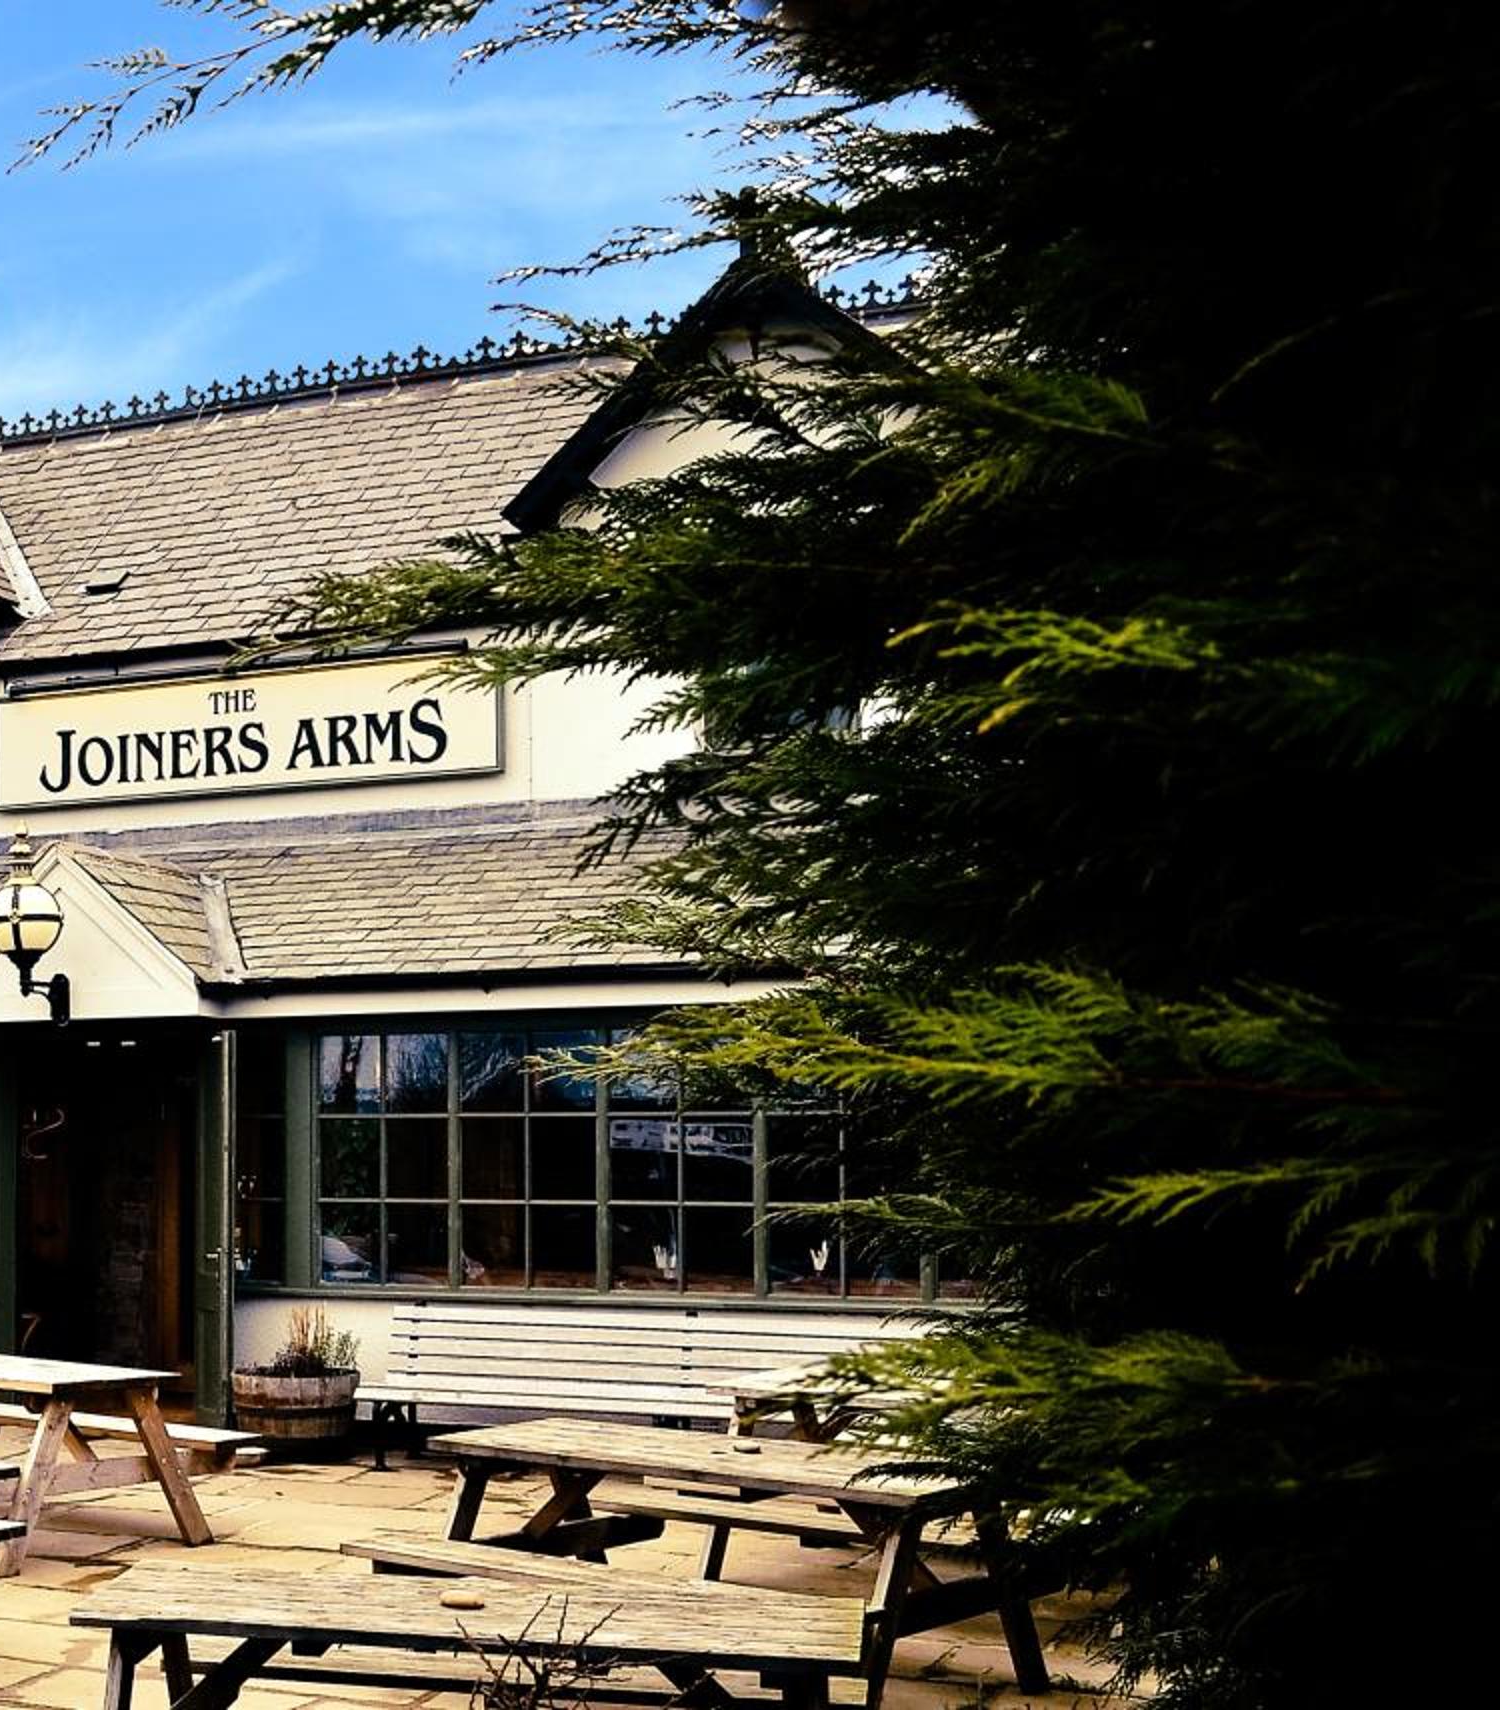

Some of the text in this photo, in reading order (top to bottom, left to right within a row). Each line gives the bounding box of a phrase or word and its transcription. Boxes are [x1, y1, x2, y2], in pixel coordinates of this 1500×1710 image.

[208, 688, 257, 716] THE
[39, 698, 448, 793] JOINERS ARMS
